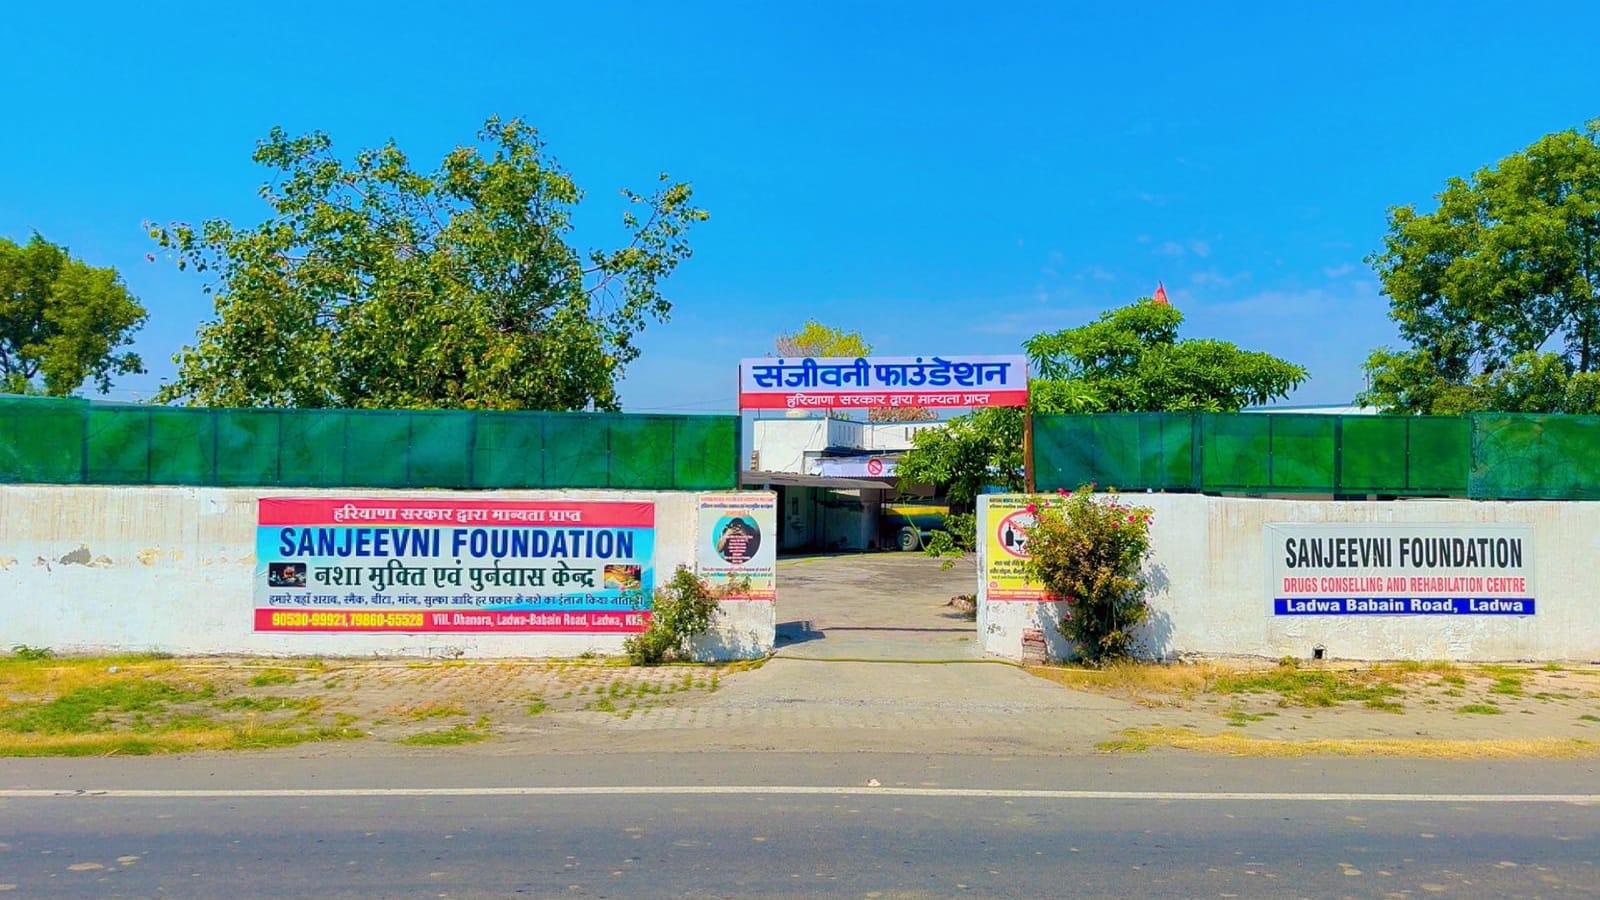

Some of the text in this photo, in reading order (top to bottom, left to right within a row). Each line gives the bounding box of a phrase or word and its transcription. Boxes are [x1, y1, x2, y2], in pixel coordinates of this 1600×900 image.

[752, 357, 1010, 387] संजीवनी फाउंडेशन
[786, 392, 990, 408] हरियाणा सरकार द्वारा मान्यता प्राप्त
[333, 504, 582, 524] हरियाणा सरकार द्वारा मान्यता प्राप्त
[279, 527, 634, 559] SANJEEVNI FOUNDATION
[1286, 538, 1522, 568] SANJEEVNI FOUNDATION
[315, 559, 595, 591] नशा मुक्ति एवं पुर्नवास केन्द्र
[1284, 577, 1525, 592] DRUGS CONSELLING AND REHABILATION CENTRE
[269, 592, 292, 605] हमारे
[294, 592, 311, 605] यहाँ
[451, 593, 473, 605] आदि
[476, 596, 487, 606] हर
[489, 595, 513, 606] प्रकार
[515, 593, 524, 605] के
[544, 595, 556, 605] का
[1287, 599, 1523, 613] Ladwa Babain Road, Ladwa
[433, 614, 451, 626] Vill.
[497, 614, 562, 627] Ladwa-Babain
[564, 614, 589, 628] Road,
[592, 614, 623, 628] Ladwa,
